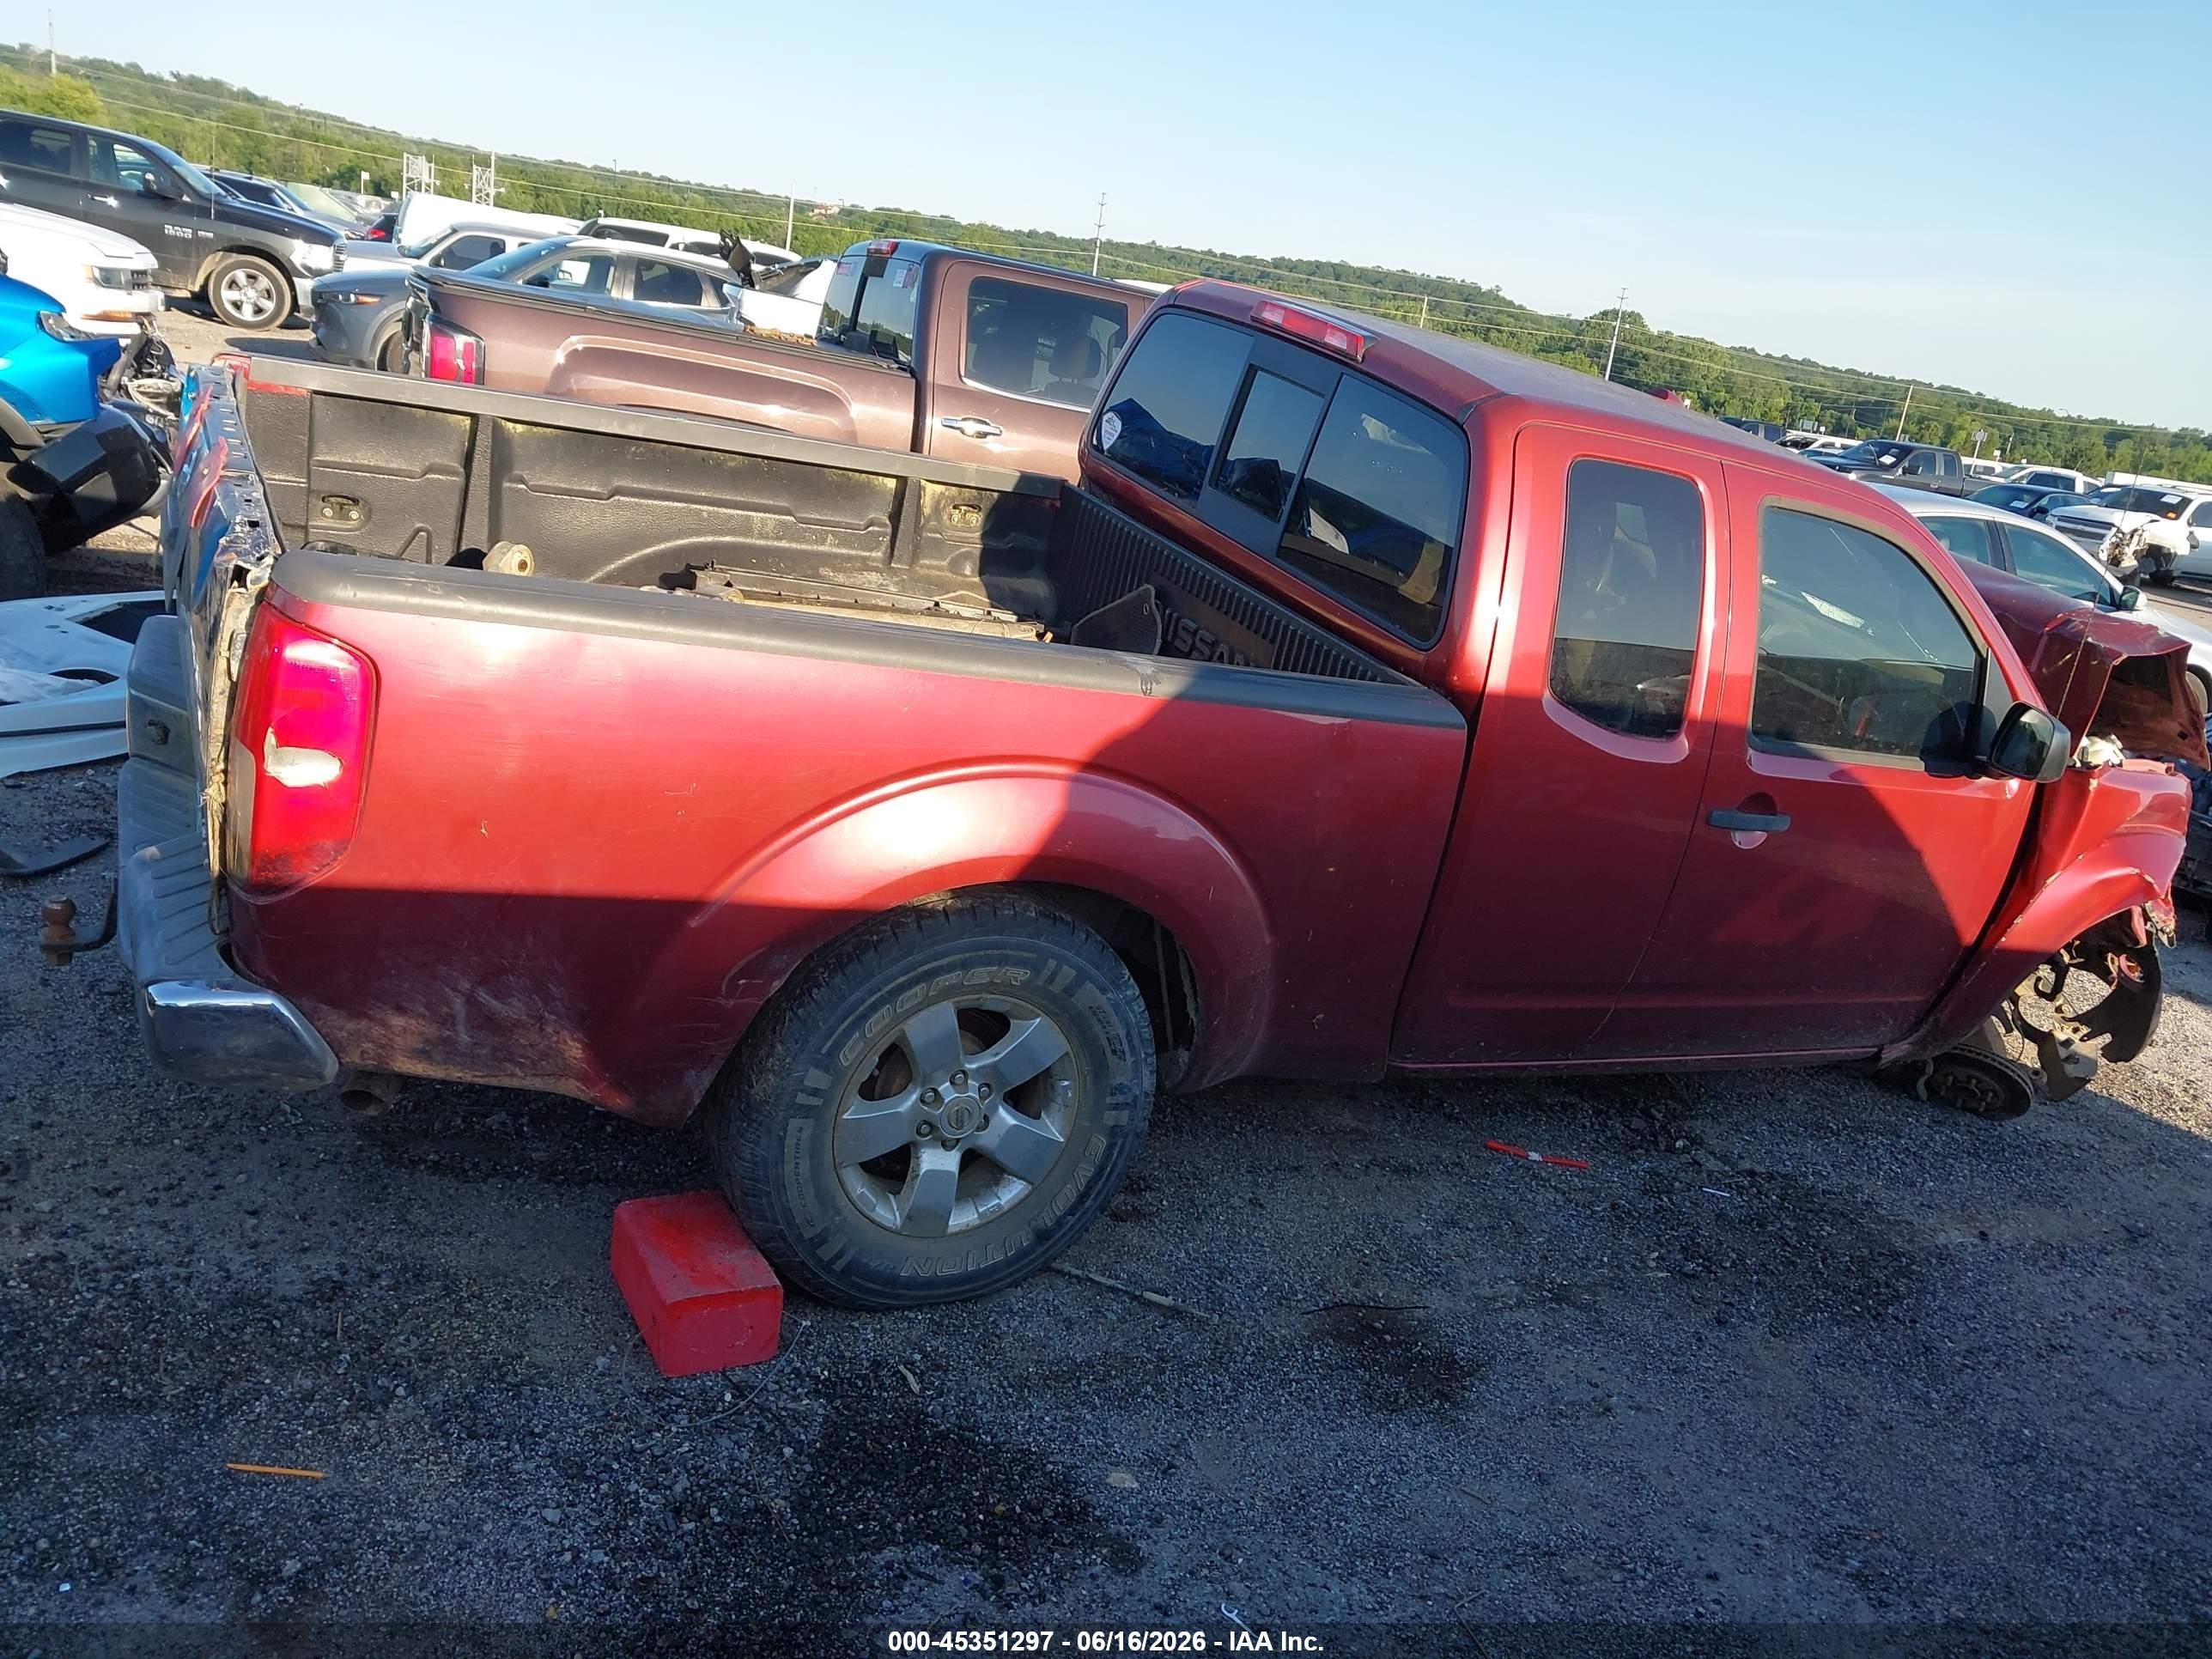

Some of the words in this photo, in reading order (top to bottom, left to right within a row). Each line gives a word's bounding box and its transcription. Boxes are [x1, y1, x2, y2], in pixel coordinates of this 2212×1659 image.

[164, 224, 192, 234] RAM
[839, 967, 1030, 1066] COOPER
[900, 1133, 1107, 1278] EVOLUTION
